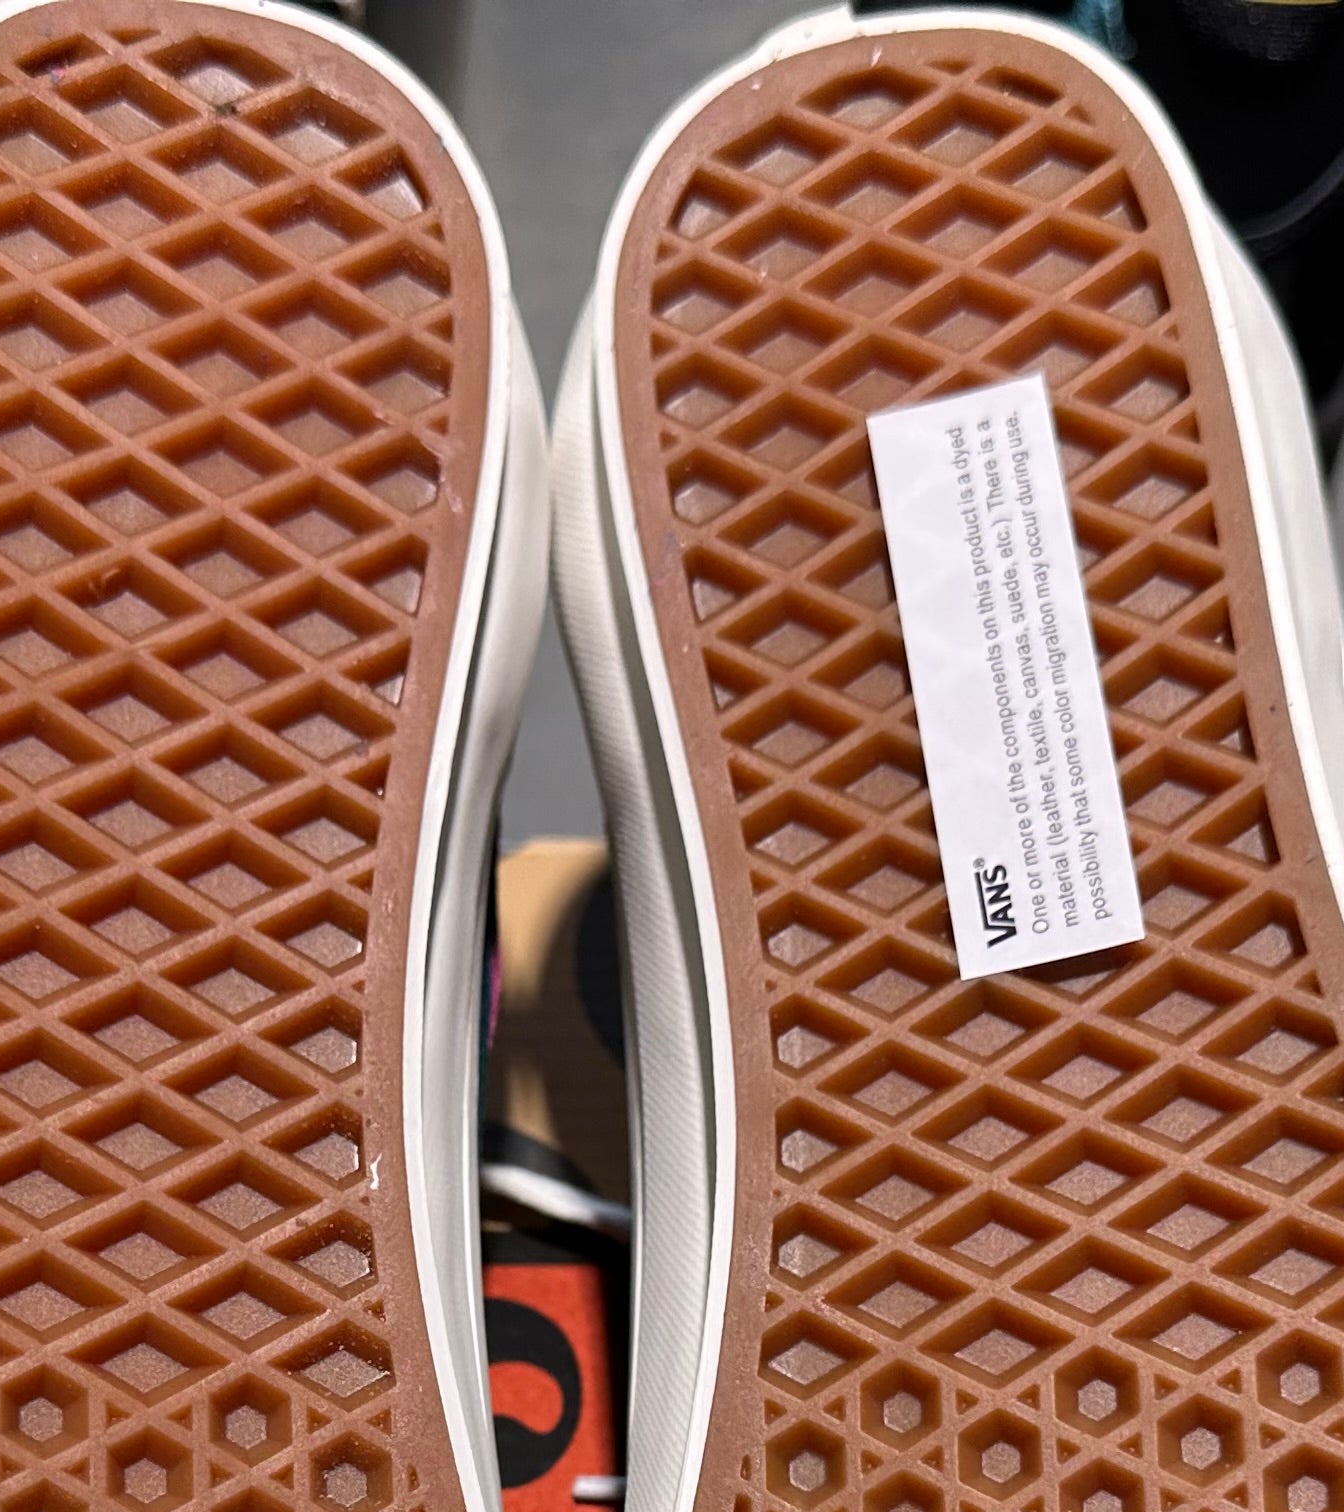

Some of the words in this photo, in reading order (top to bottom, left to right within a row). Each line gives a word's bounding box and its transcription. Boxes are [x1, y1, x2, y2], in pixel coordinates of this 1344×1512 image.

[944, 424, 971, 470] dyed
[975, 417, 991, 433] a
[976, 435, 996, 456] is
[1004, 409, 1024, 449] use.
[956, 471, 972, 485] a
[956, 485, 976, 506] is
[982, 457, 1005, 513] There
[1010, 448, 1034, 506] during
[959, 505, 993, 577] product
[989, 516, 1014, 559] etc.)
[1020, 509, 1044, 558] occur
[975, 578, 995, 615] this
[1000, 560, 1026, 624] suede,
[1030, 560, 1051, 599] may
[981, 615, 1000, 641] on
[1038, 600, 1067, 686] migration
[1014, 625, 1040, 699] canvas,
[984, 642, 1020, 758] components
[1052, 688, 1076, 734] color
[1025, 700, 1051, 766] textile,
[1005, 760, 1026, 793] the
[1062, 735, 1085, 787] some
[1008, 794, 1030, 814] of
[1038, 766, 1070, 846] (leather,
[1068, 787, 1093, 827] that
[1016, 816, 1040, 867] more
[1025, 870, 1044, 890] or
[1048, 850, 1080, 928] material
[1077, 829, 1113, 921] possibility
[1030, 893, 1051, 935] One
